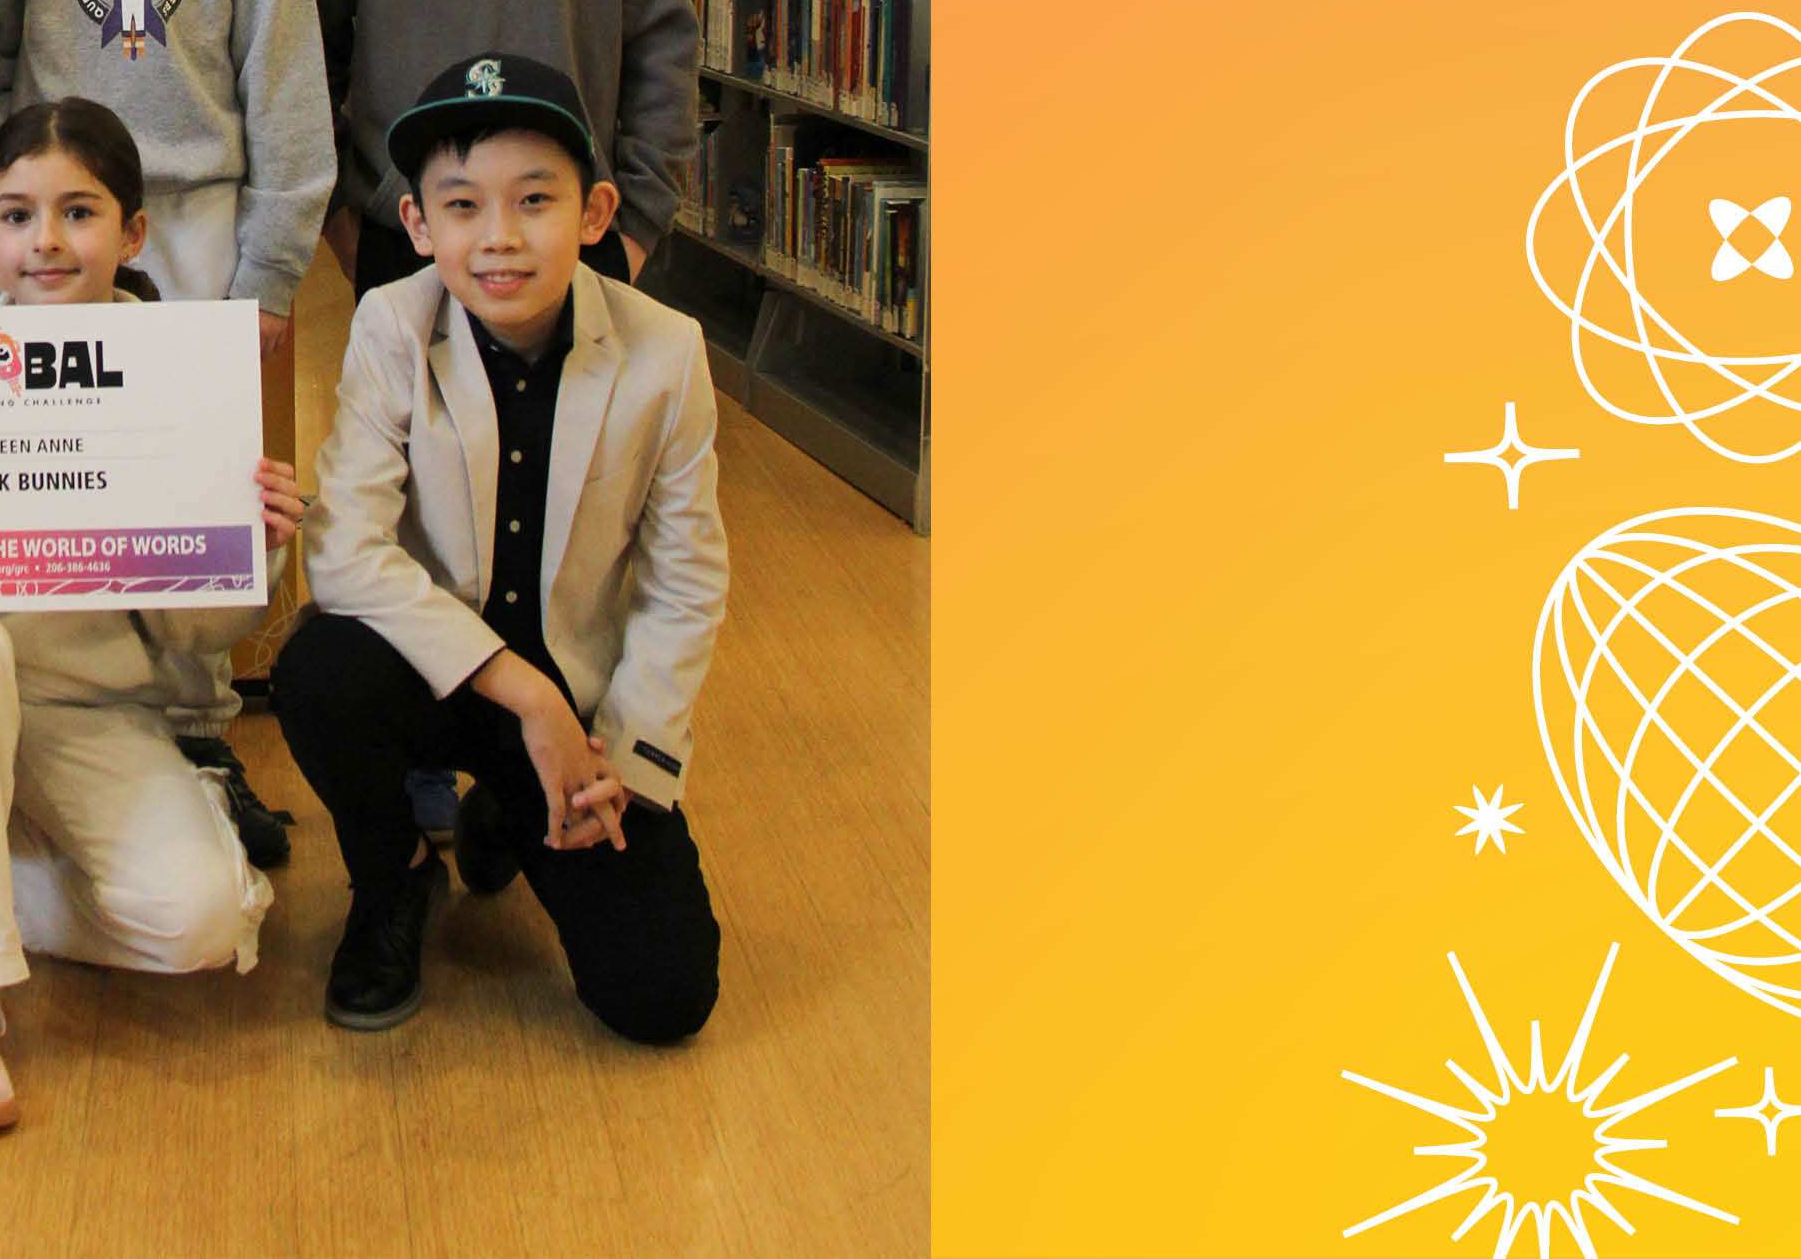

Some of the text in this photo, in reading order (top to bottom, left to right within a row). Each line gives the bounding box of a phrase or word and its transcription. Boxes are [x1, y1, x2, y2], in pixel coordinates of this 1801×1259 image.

[23, 397, 102, 407] CHALLENGE
[37, 438, 85, 453] ANNE
[18, 470, 108, 491] BUNNIES
[23, 537, 97, 558] WORLD
[101, 536, 128, 556] OF
[132, 534, 207, 556] WORDS
